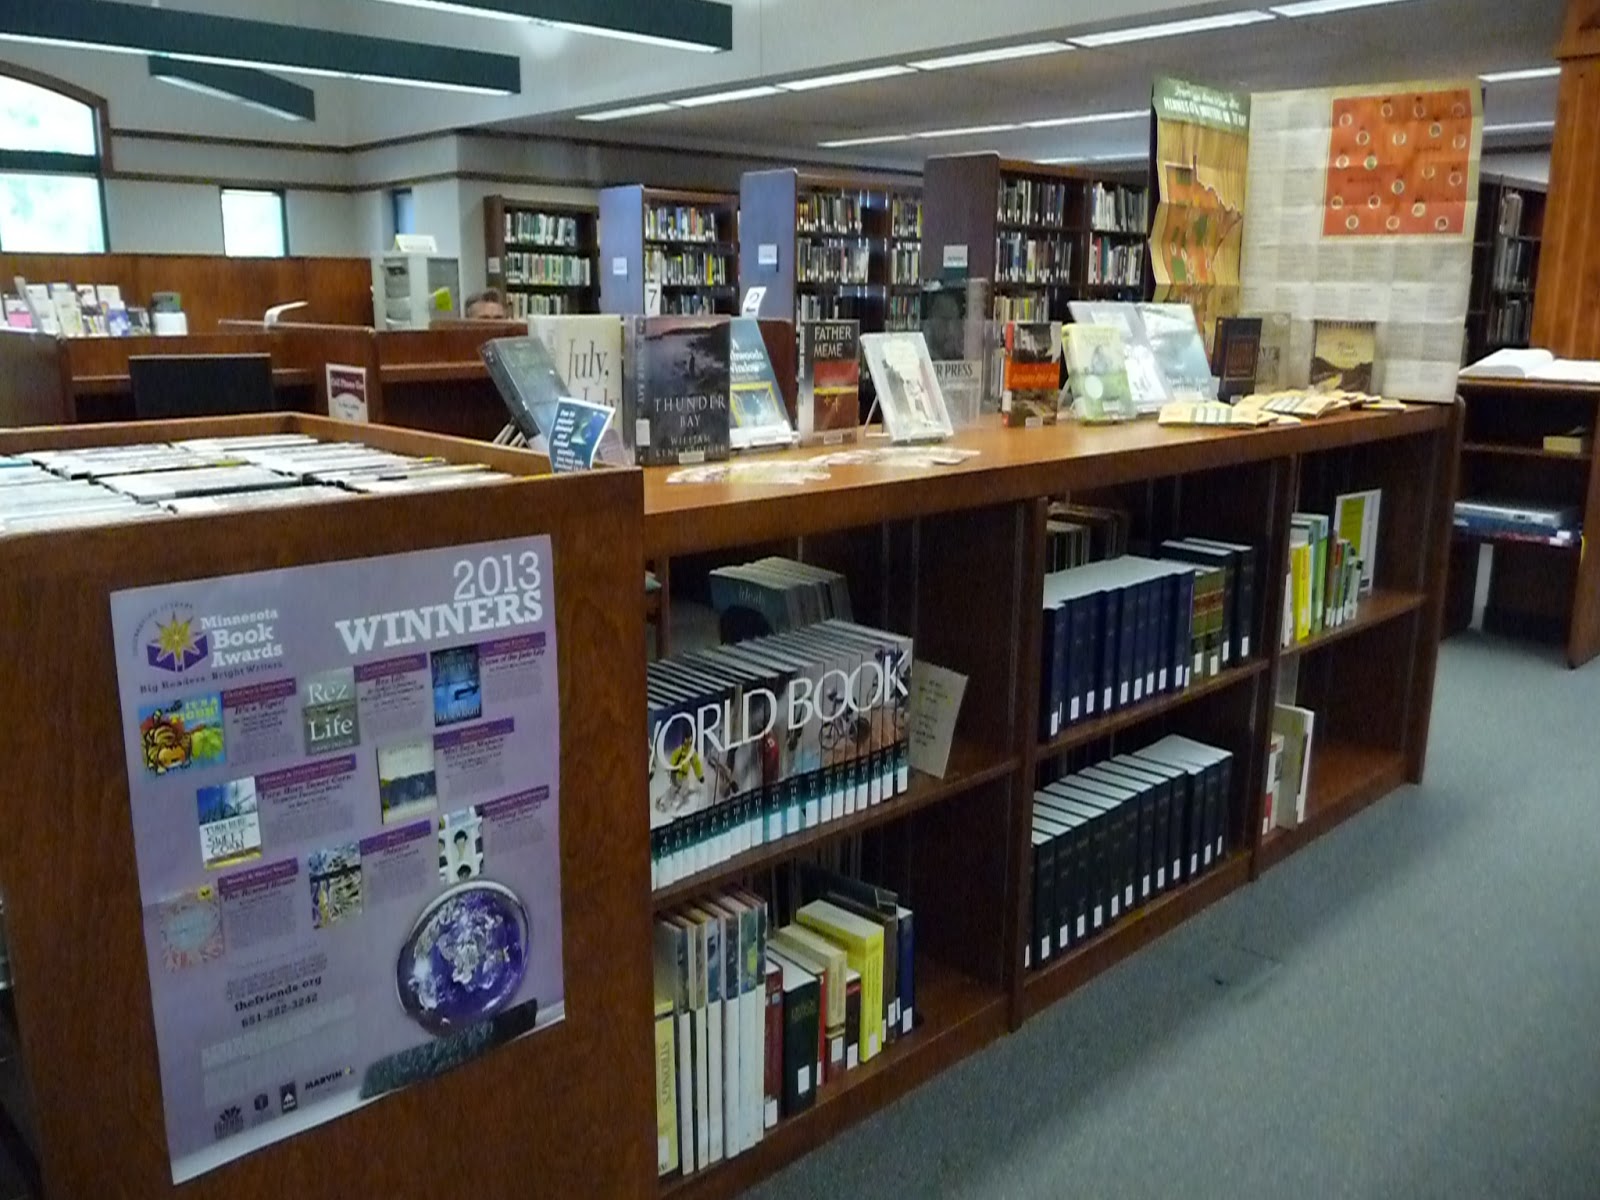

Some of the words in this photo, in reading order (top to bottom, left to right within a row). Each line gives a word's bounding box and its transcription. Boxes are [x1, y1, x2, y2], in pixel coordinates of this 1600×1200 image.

[648, 289, 657, 308] 7
[814, 325, 852, 341] FATHER
[813, 343, 844, 359] MEME
[568, 339, 609, 386] July,
[945, 363, 973, 378] PRESS
[654, 395, 726, 412] THUNDER
[680, 414, 701, 428] BAY
[453, 551, 541, 600] 2013
[201, 609, 278, 630] Minnesota
[335, 590, 544, 655] WINNERS
[211, 624, 275, 650] Book
[211, 643, 284, 668] Awards
[140, 683, 158, 695] Big
[212, 668, 244, 681] Bright
[787, 649, 909, 731] BOOK
[308, 683, 348, 705] Rez
[309, 715, 353, 741] Life
[204, 822, 227, 835] TURN
[234, 976, 322, 1013] thefriends.org
[305, 1070, 342, 1091] MARVIN
